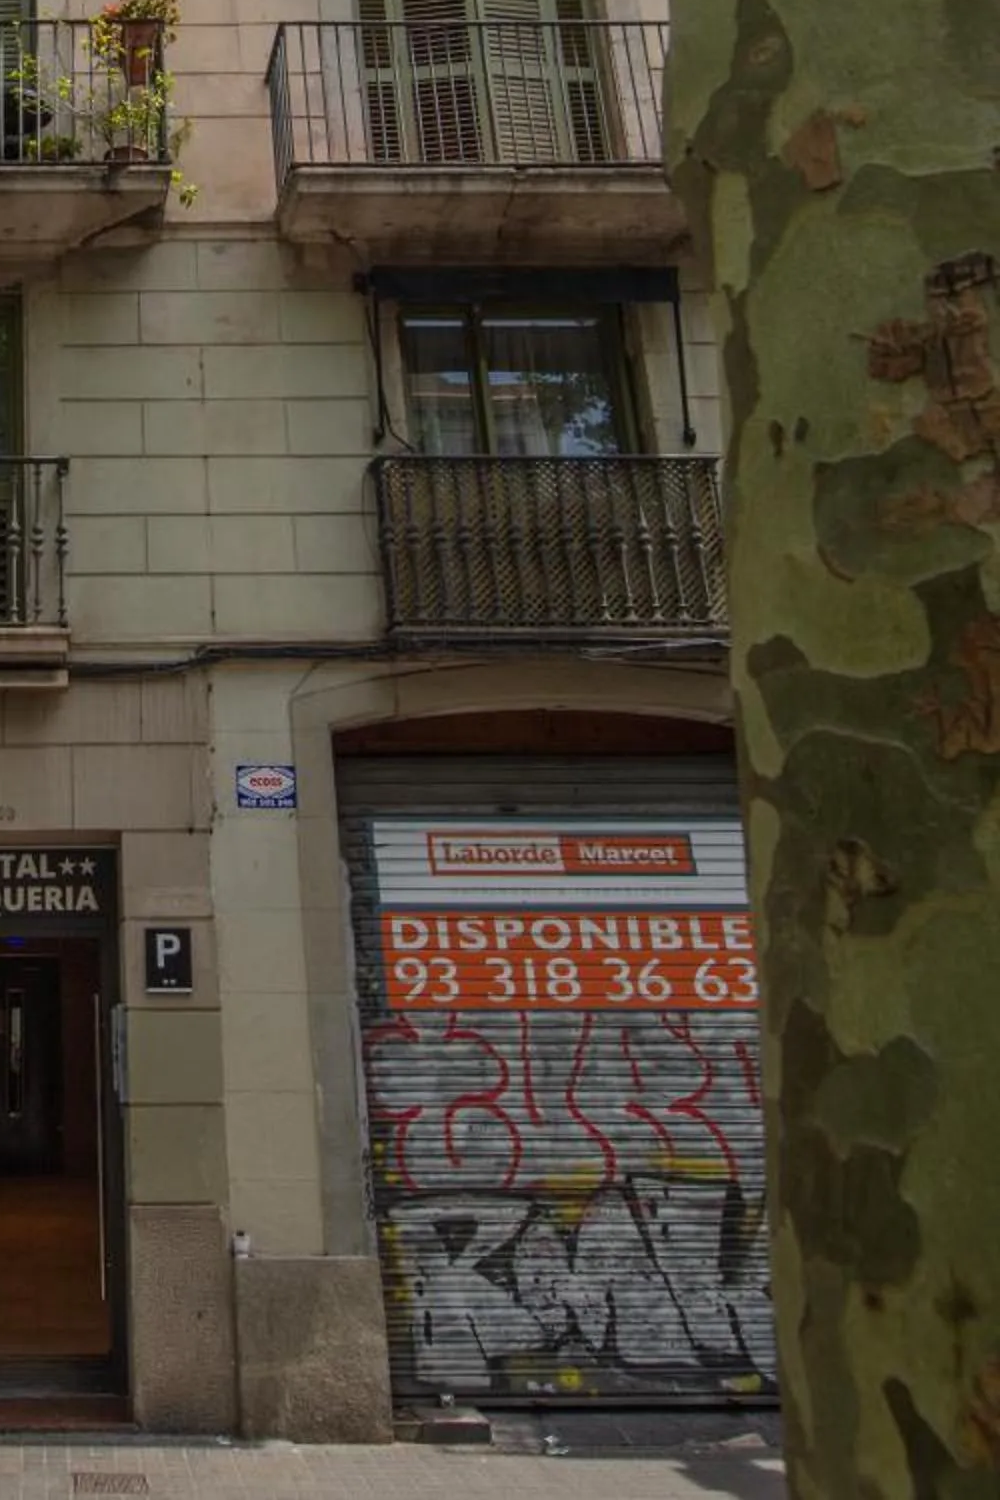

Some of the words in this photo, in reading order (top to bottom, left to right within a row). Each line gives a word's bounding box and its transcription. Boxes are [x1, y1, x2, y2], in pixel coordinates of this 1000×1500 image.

[443, 841, 556, 865] Laborde
[578, 842, 678, 866] Marcet
[156, 932, 181, 969] P
[391, 915, 754, 950] DISPONIBLE
[393, 957, 460, 1001] 93
[484, 957, 582, 1002] 318
[602, 957, 671, 1002] 36
[694, 957, 758, 1002] 63
